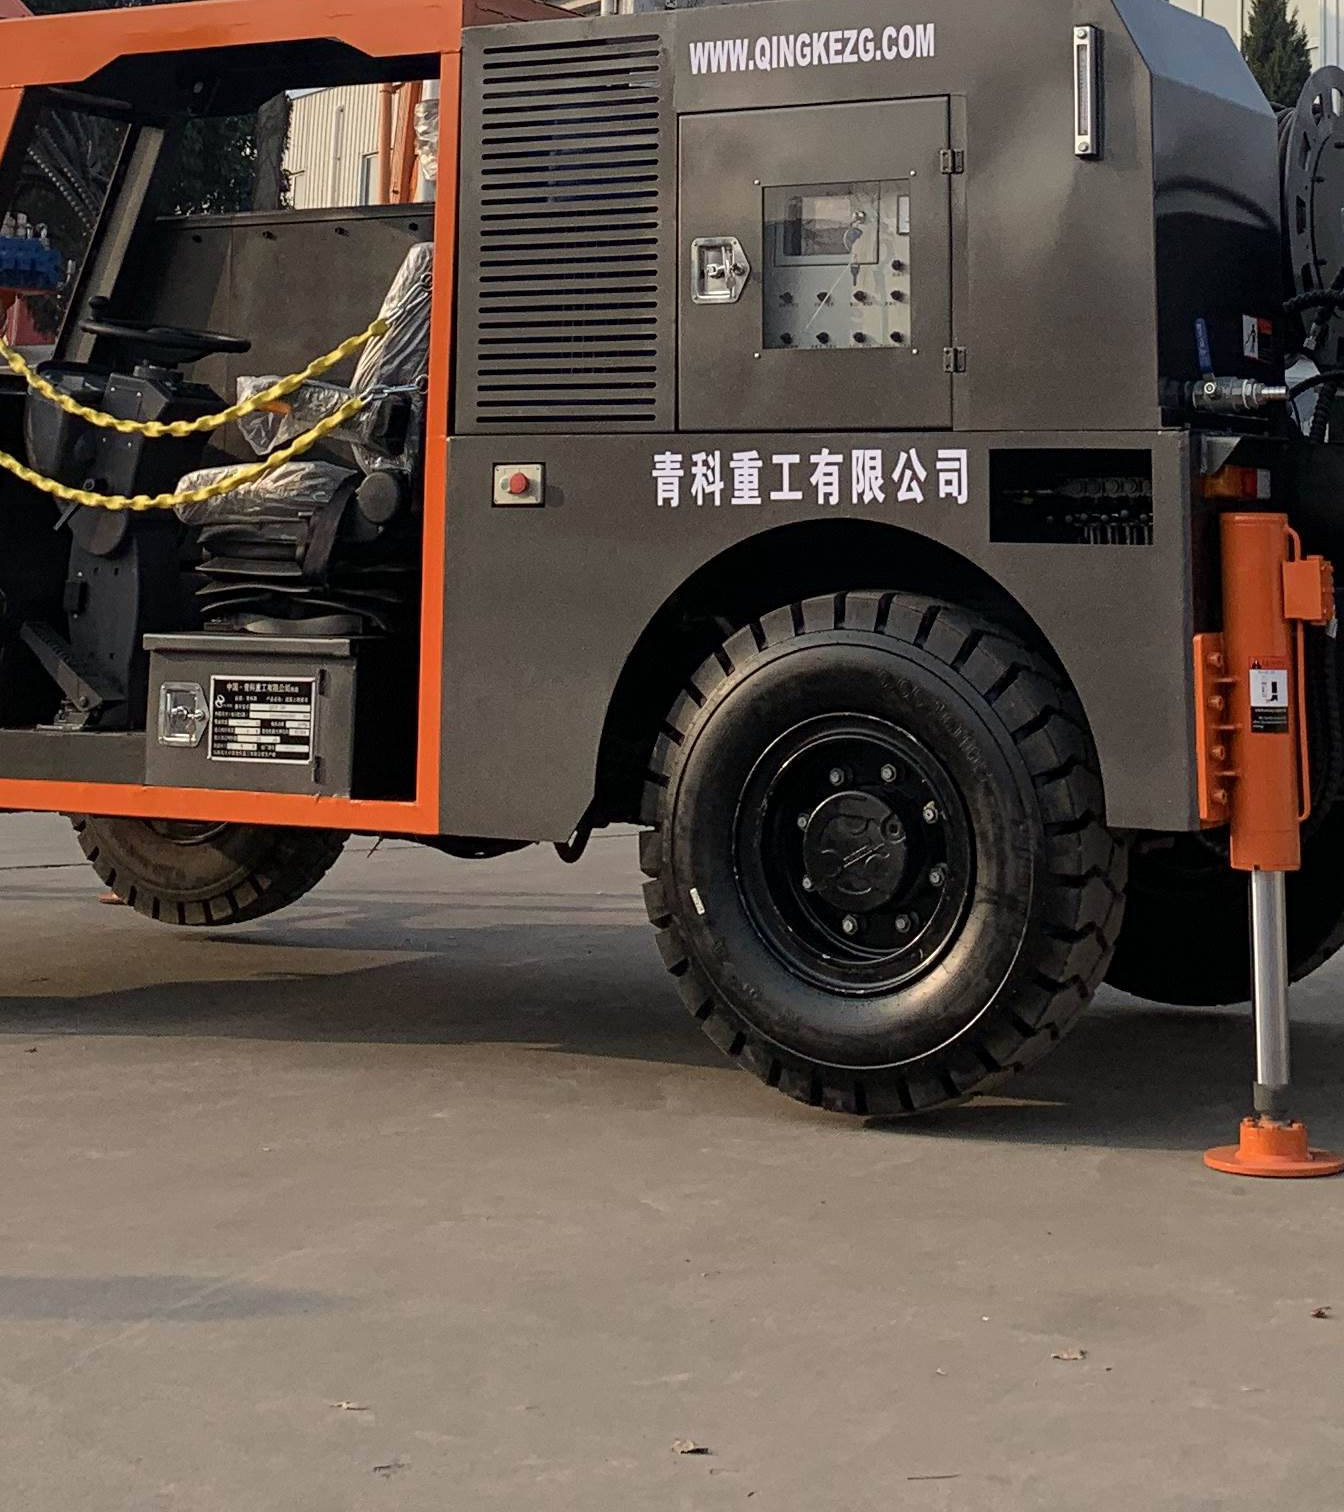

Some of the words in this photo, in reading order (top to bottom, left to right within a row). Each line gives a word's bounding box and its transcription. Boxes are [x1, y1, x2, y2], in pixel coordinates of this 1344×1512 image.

[689, 23, 935, 75] WWW.QINGKEZG.COM
[652, 448, 968, 507] 青科重工有限公司
